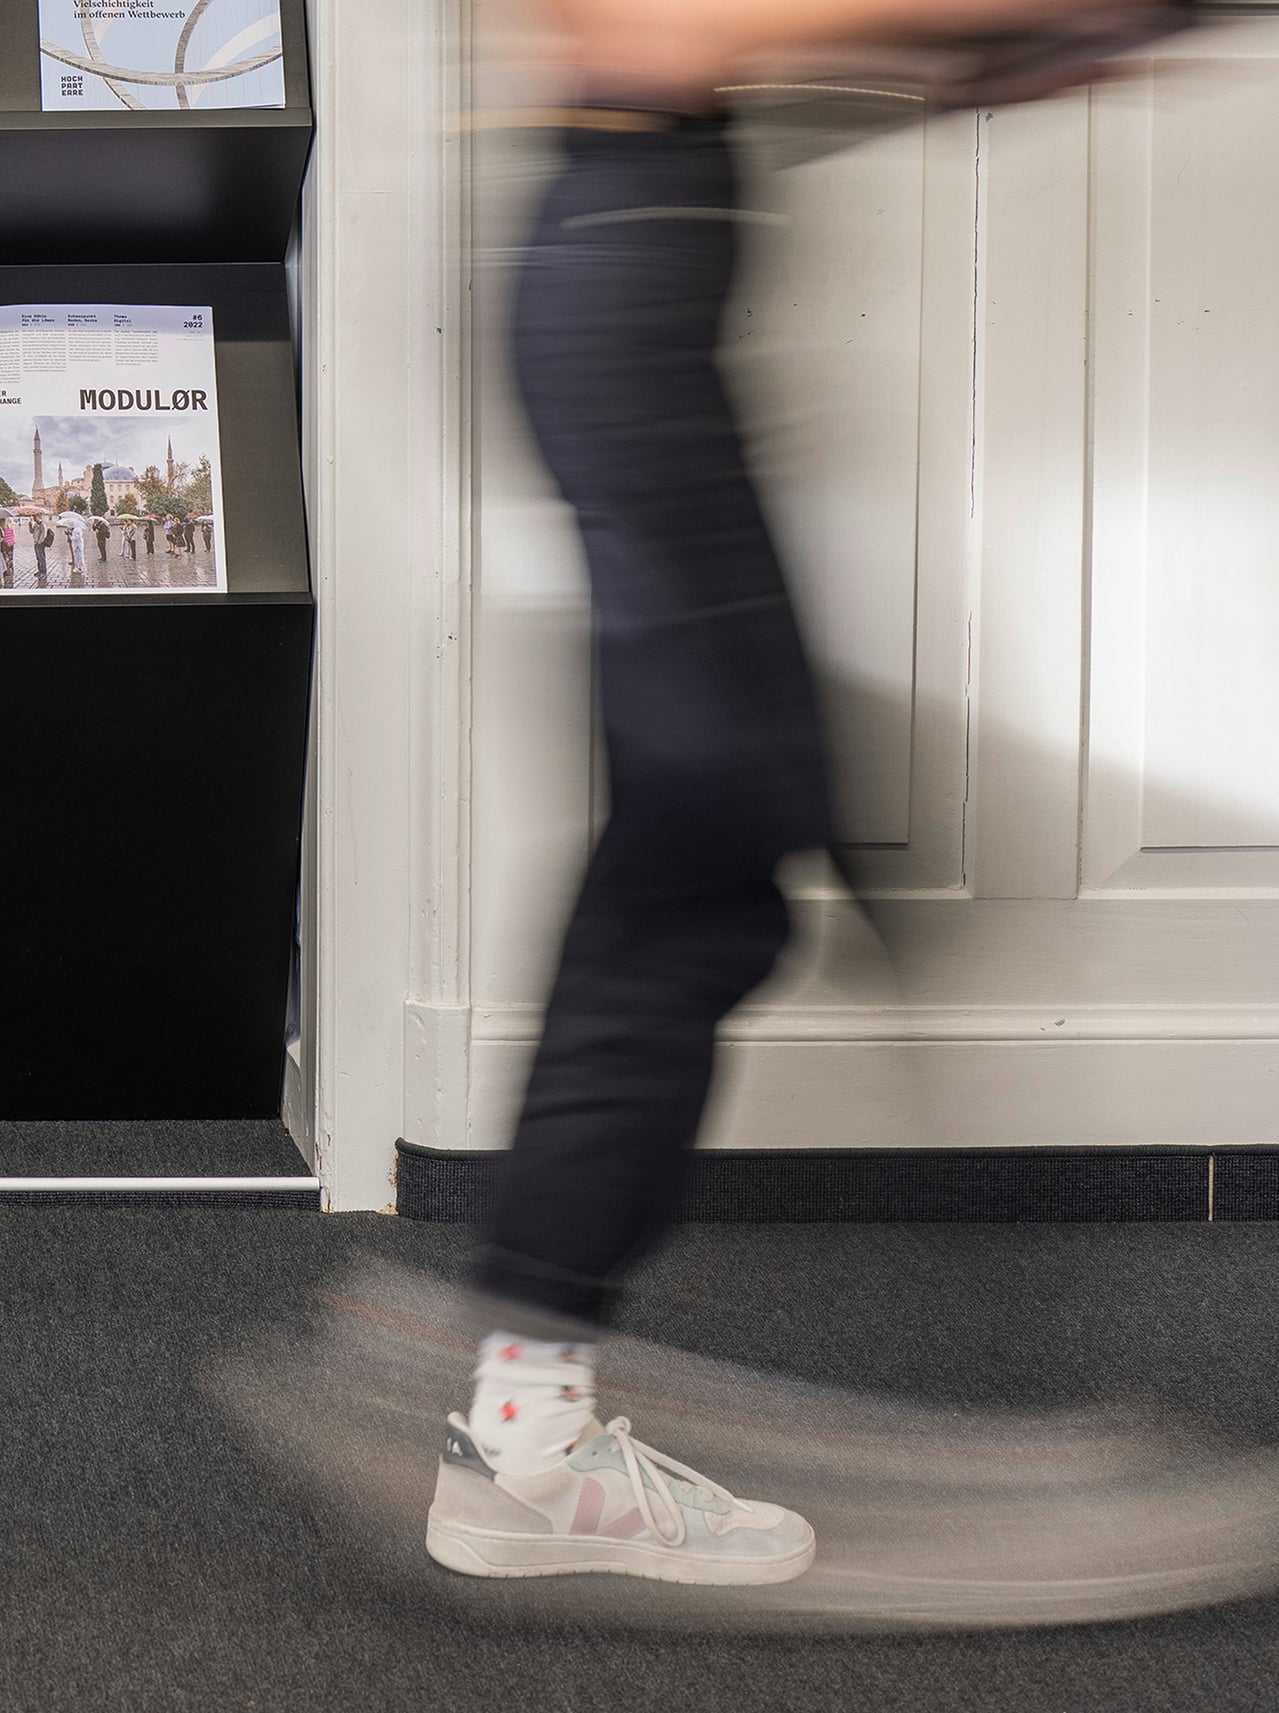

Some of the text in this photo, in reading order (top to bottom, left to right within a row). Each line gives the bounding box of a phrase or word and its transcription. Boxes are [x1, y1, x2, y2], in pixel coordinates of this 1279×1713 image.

[74, 0, 154, 10] Vielschichtigkeit
[74, 10, 186, 18] im offenen Wettbewerb
[80, 389, 208, 411] MODULØR
